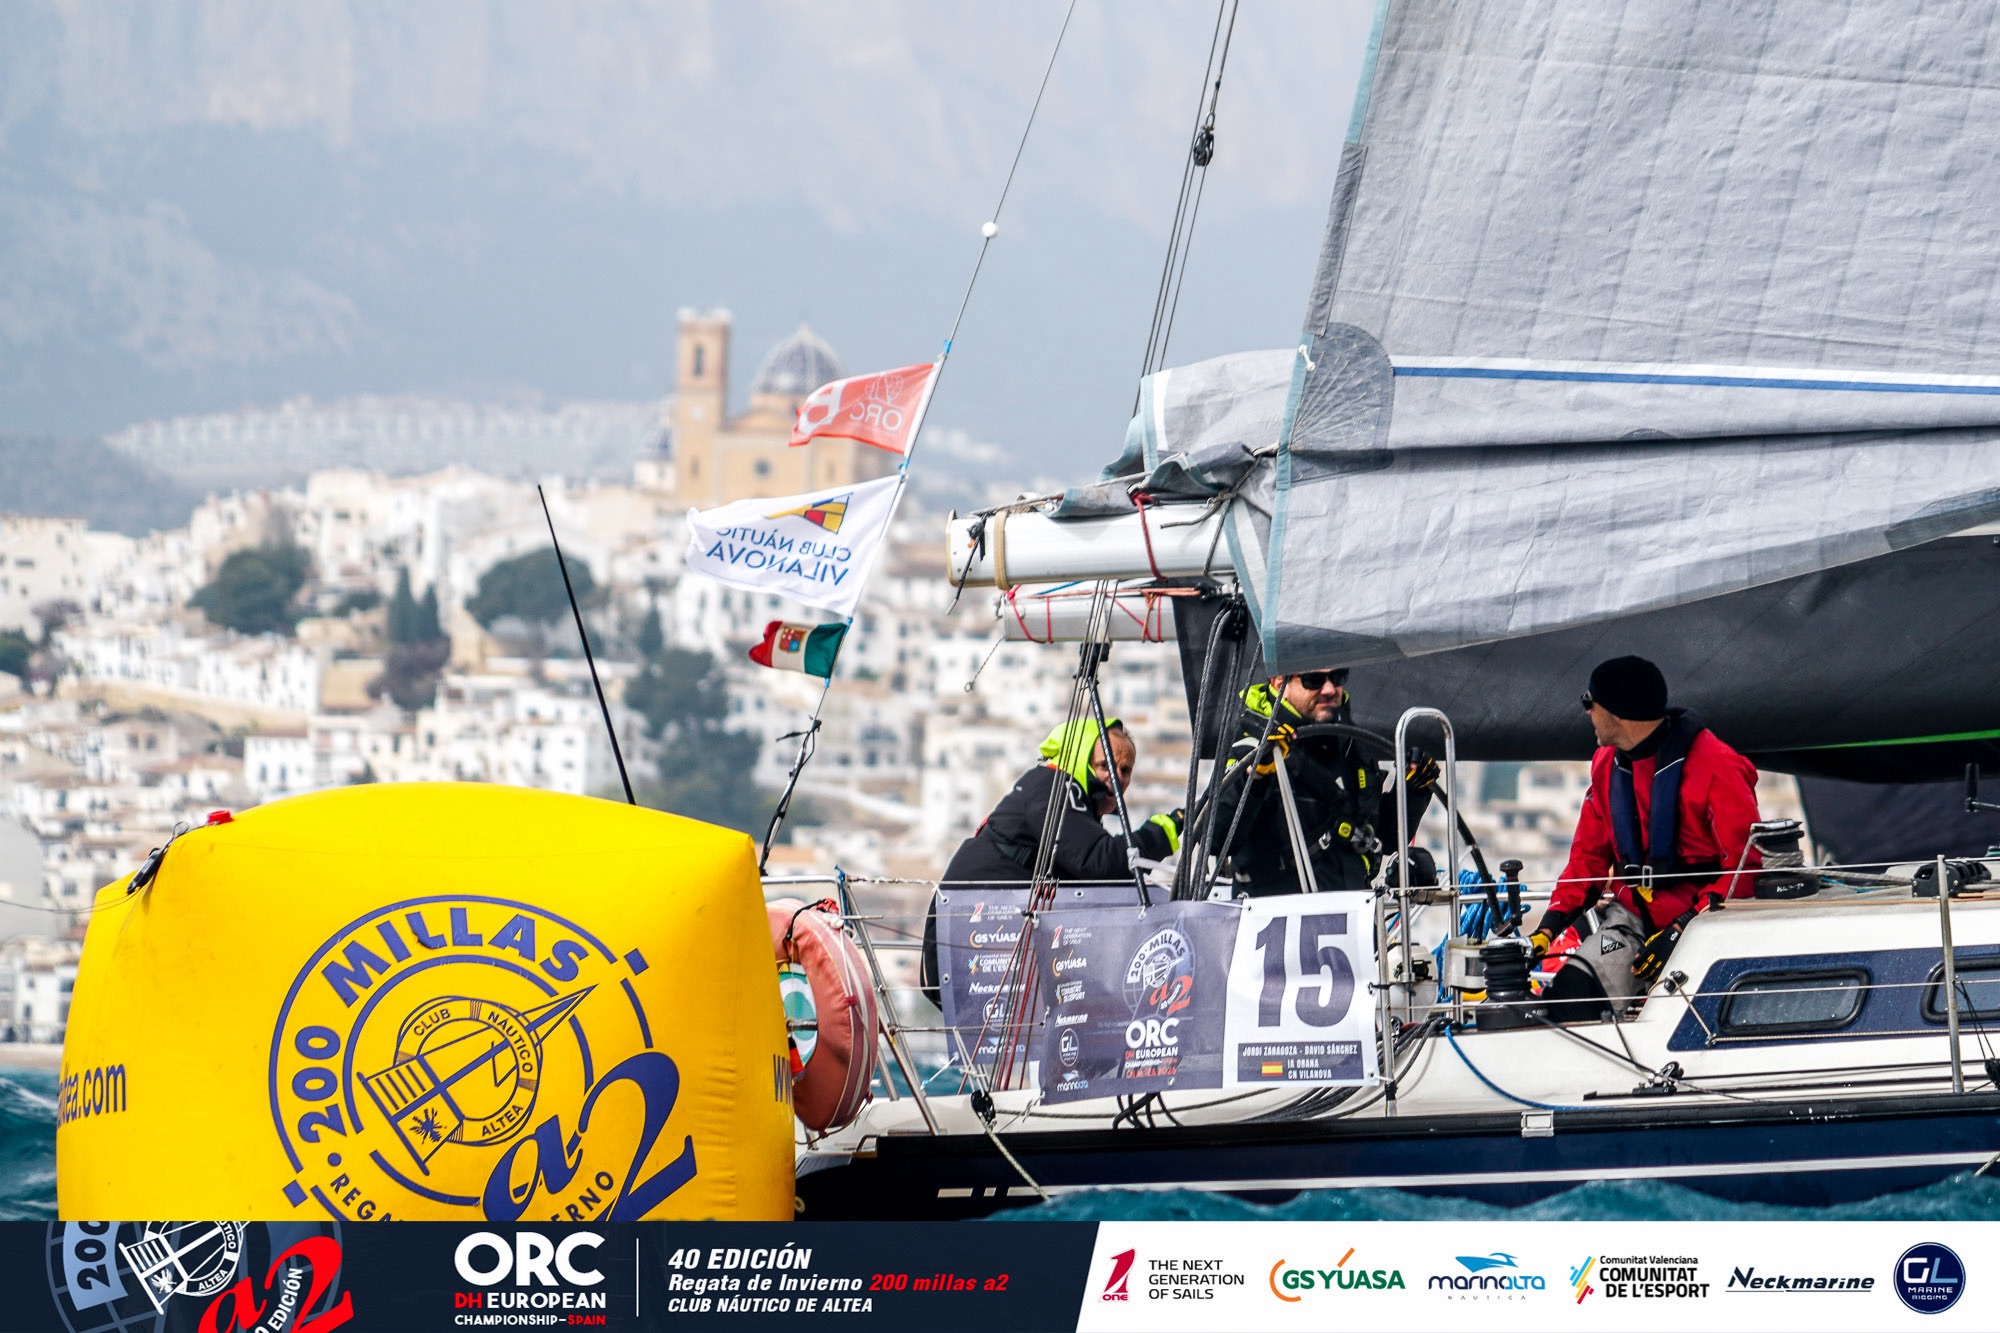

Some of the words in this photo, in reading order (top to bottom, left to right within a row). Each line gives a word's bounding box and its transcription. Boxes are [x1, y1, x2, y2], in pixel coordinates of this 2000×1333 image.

[1255, 912, 1356, 1028] 15
[292, 1025, 347, 1144] 200
[321, 906, 590, 1008] MILLAS
[413, 1007, 451, 1037] CLUB
[487, 1010, 533, 1073] NÁUTICO
[1125, 1017, 1180, 1049] ORC
[1135, 1046, 1179, 1060] EUROPEAN
[1242, 1046, 1262, 1057] JORDI
[1263, 1046, 1298, 1056] ZARAGOZA
[1304, 1045, 1325, 1055] DAVID
[1326, 1042, 1358, 1055] SÁNCHEZ
[1287, 1069, 1297, 1080] CN
[1299, 1069, 1332, 1079] VILANOVA
[481, 1103, 524, 1137] ALTEA
[482, 1051, 698, 1221] a2
